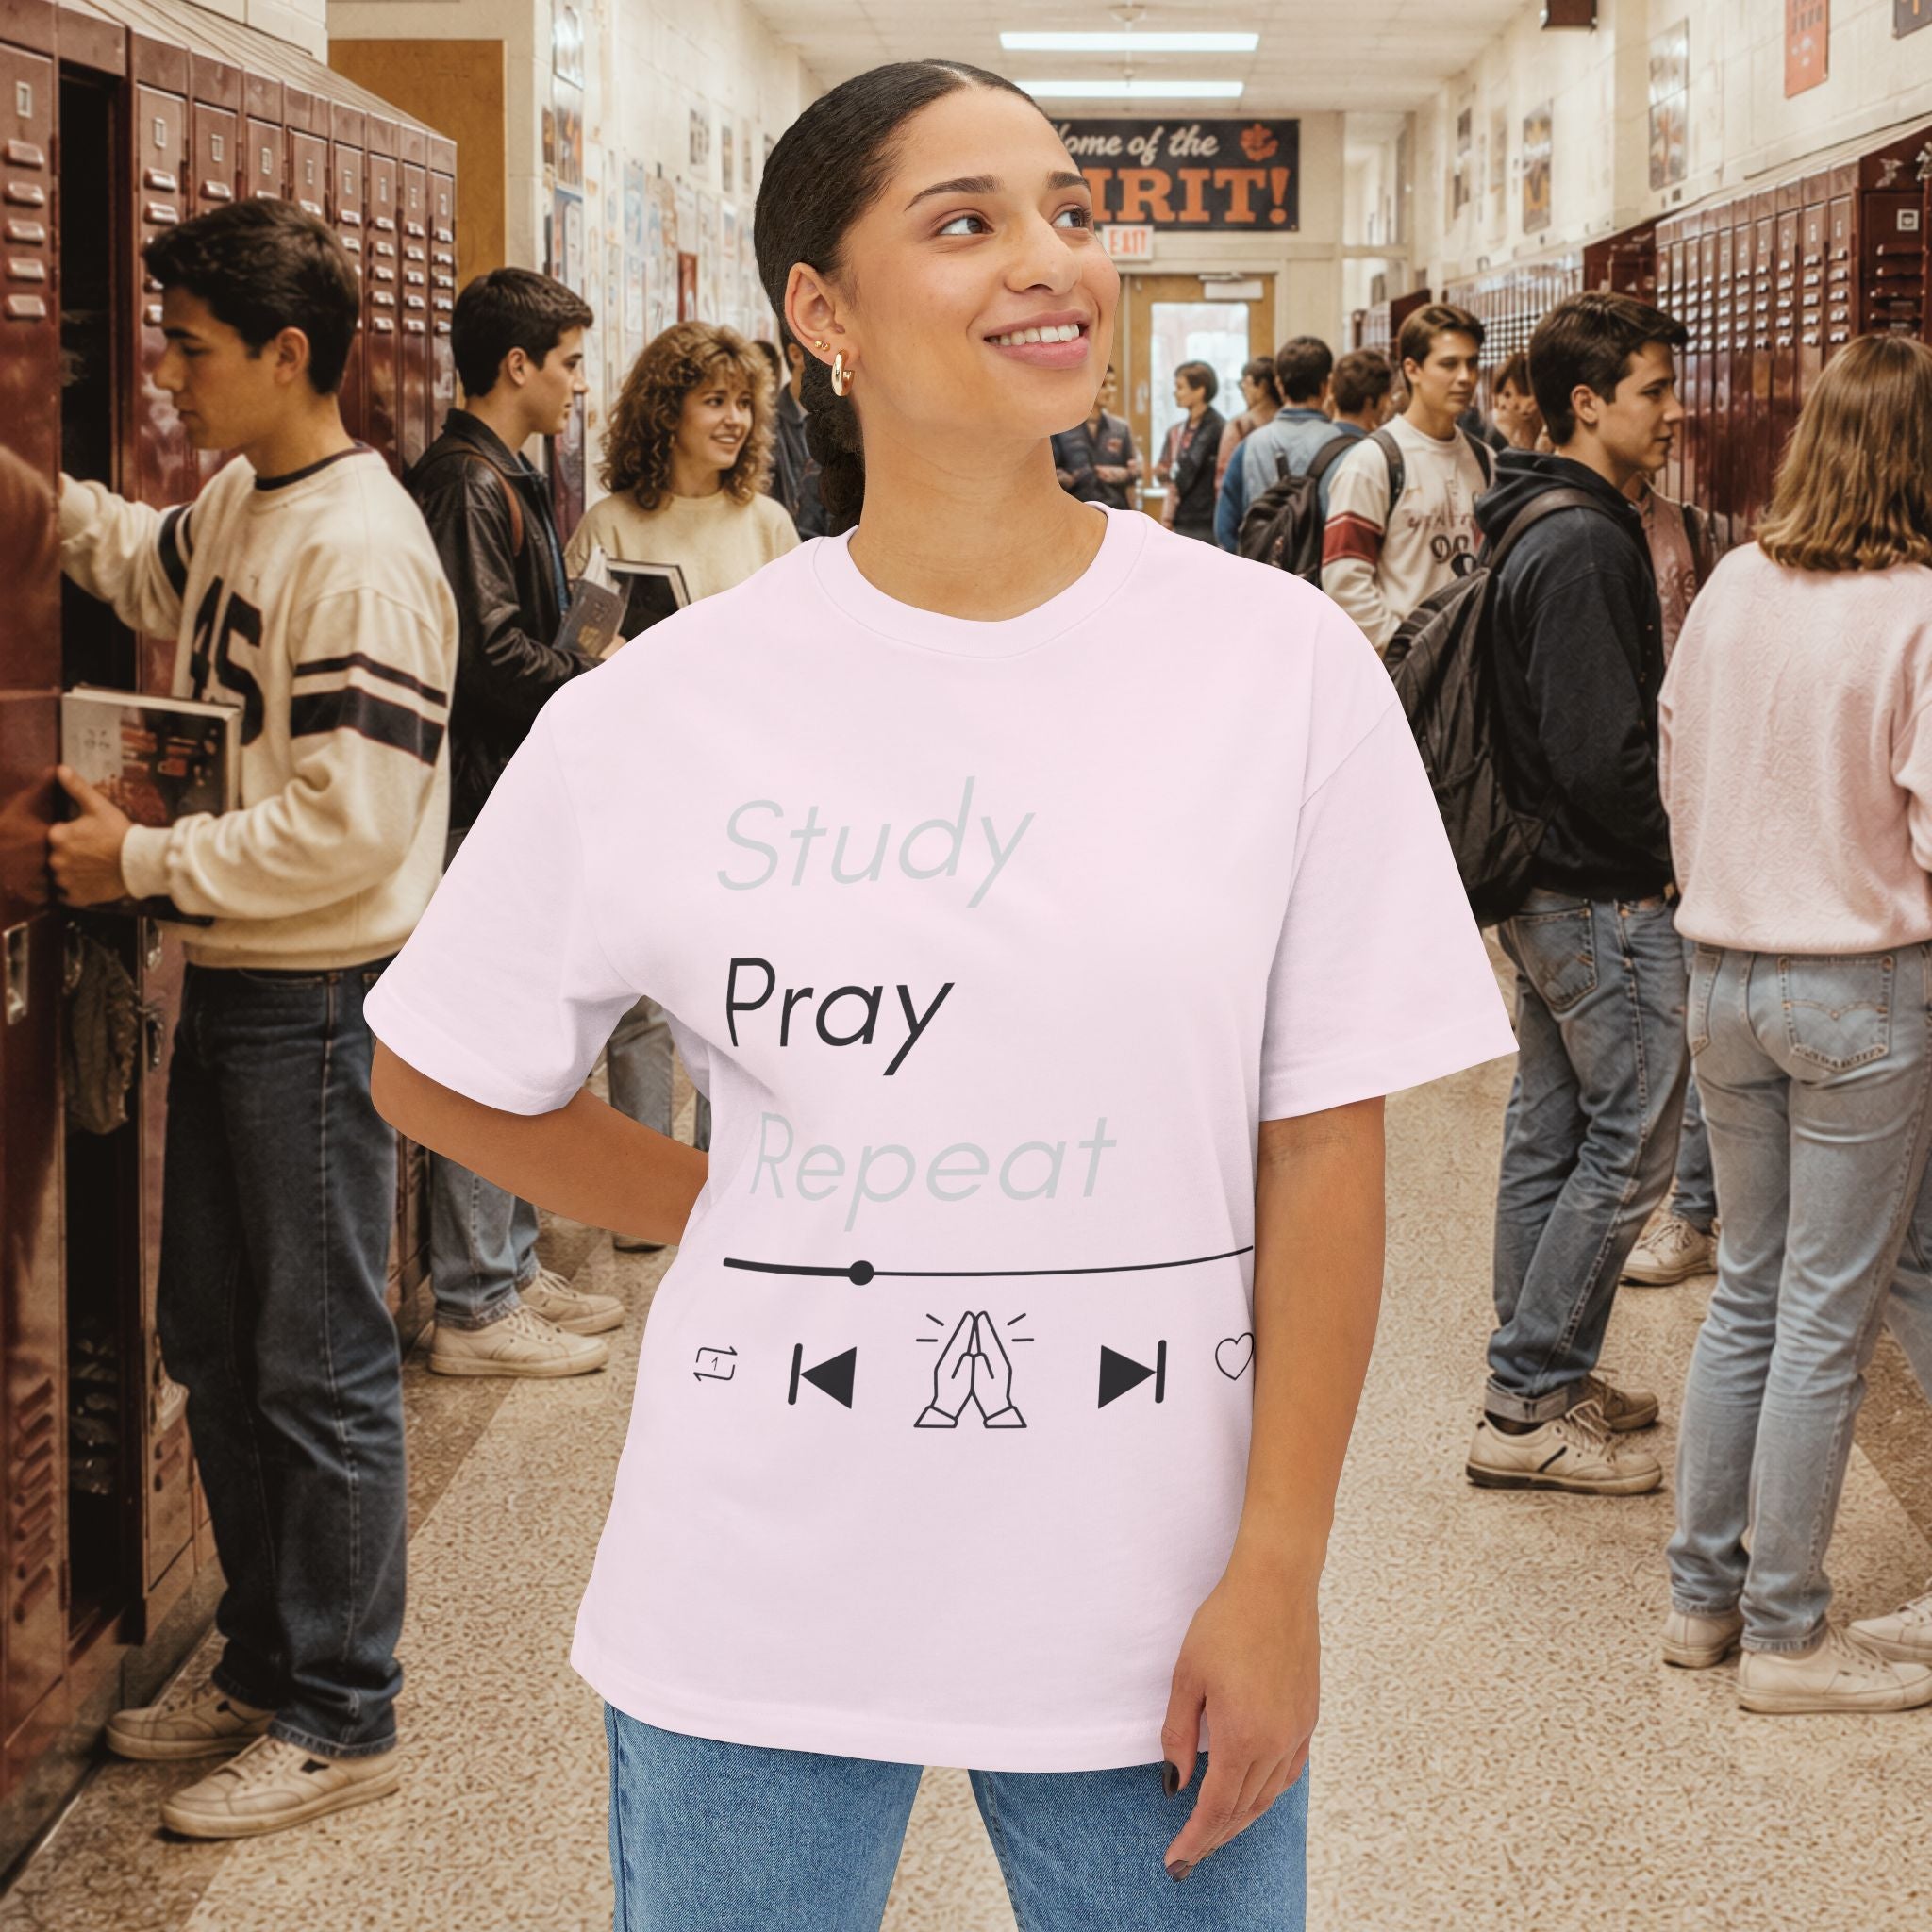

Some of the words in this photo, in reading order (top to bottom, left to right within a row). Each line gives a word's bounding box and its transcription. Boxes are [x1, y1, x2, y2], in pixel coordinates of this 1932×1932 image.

[1058, 123, 1123, 156] ome
[1127, 125, 1165, 166] of
[1168, 124, 1220, 157] the
[718, 776, 1035, 908] Study
[726, 958, 955, 1075] Pray
[751, 1112, 1117, 1232] Repeat
